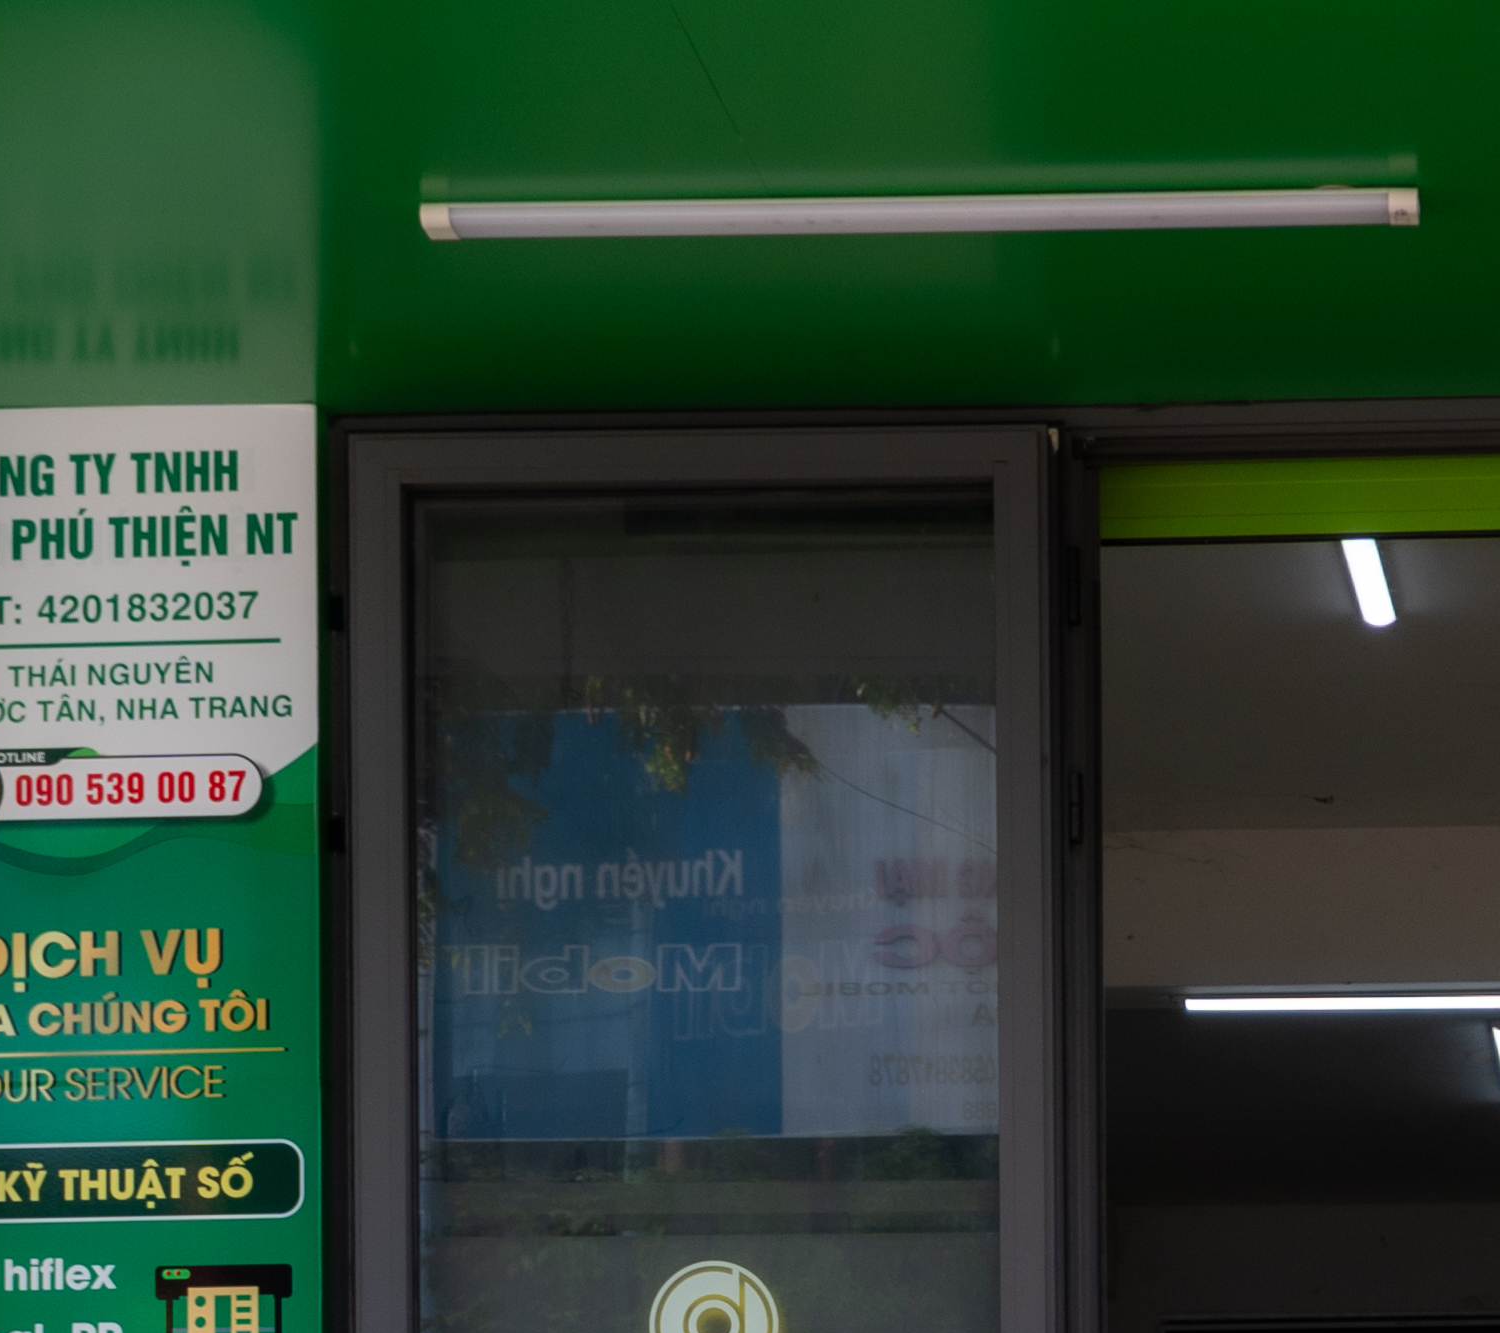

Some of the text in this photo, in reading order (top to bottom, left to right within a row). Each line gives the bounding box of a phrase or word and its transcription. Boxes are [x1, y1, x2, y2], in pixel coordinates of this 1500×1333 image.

[69, 453, 115, 495] TY
[130, 451, 237, 493] TNHH
[12, 508, 93, 560] PHÚ
[109, 507, 227, 566] THIỆN
[247, 512, 297, 555] NT
[38, 591, 258, 624] 4201832037
[8, 659, 76, 687] THÁI
[88, 656, 213, 685] NGUYÊN
[37, 696, 104, 725] TÂN,
[117, 698, 178, 720] NHA
[189, 695, 292, 719] TRANG
[15, 770, 246, 806] 090 539 00 87
[140, 928, 221, 988] VỤ
[28, 993, 187, 1035] CHÚNG
[199, 989, 267, 1032] TÔI
[65, 1065, 224, 1100] SERVICE
[59, 1159, 185, 1209] THUẬT
[197, 1152, 254, 1198] SỐ
[4, 1258, 116, 1291] hiflex
